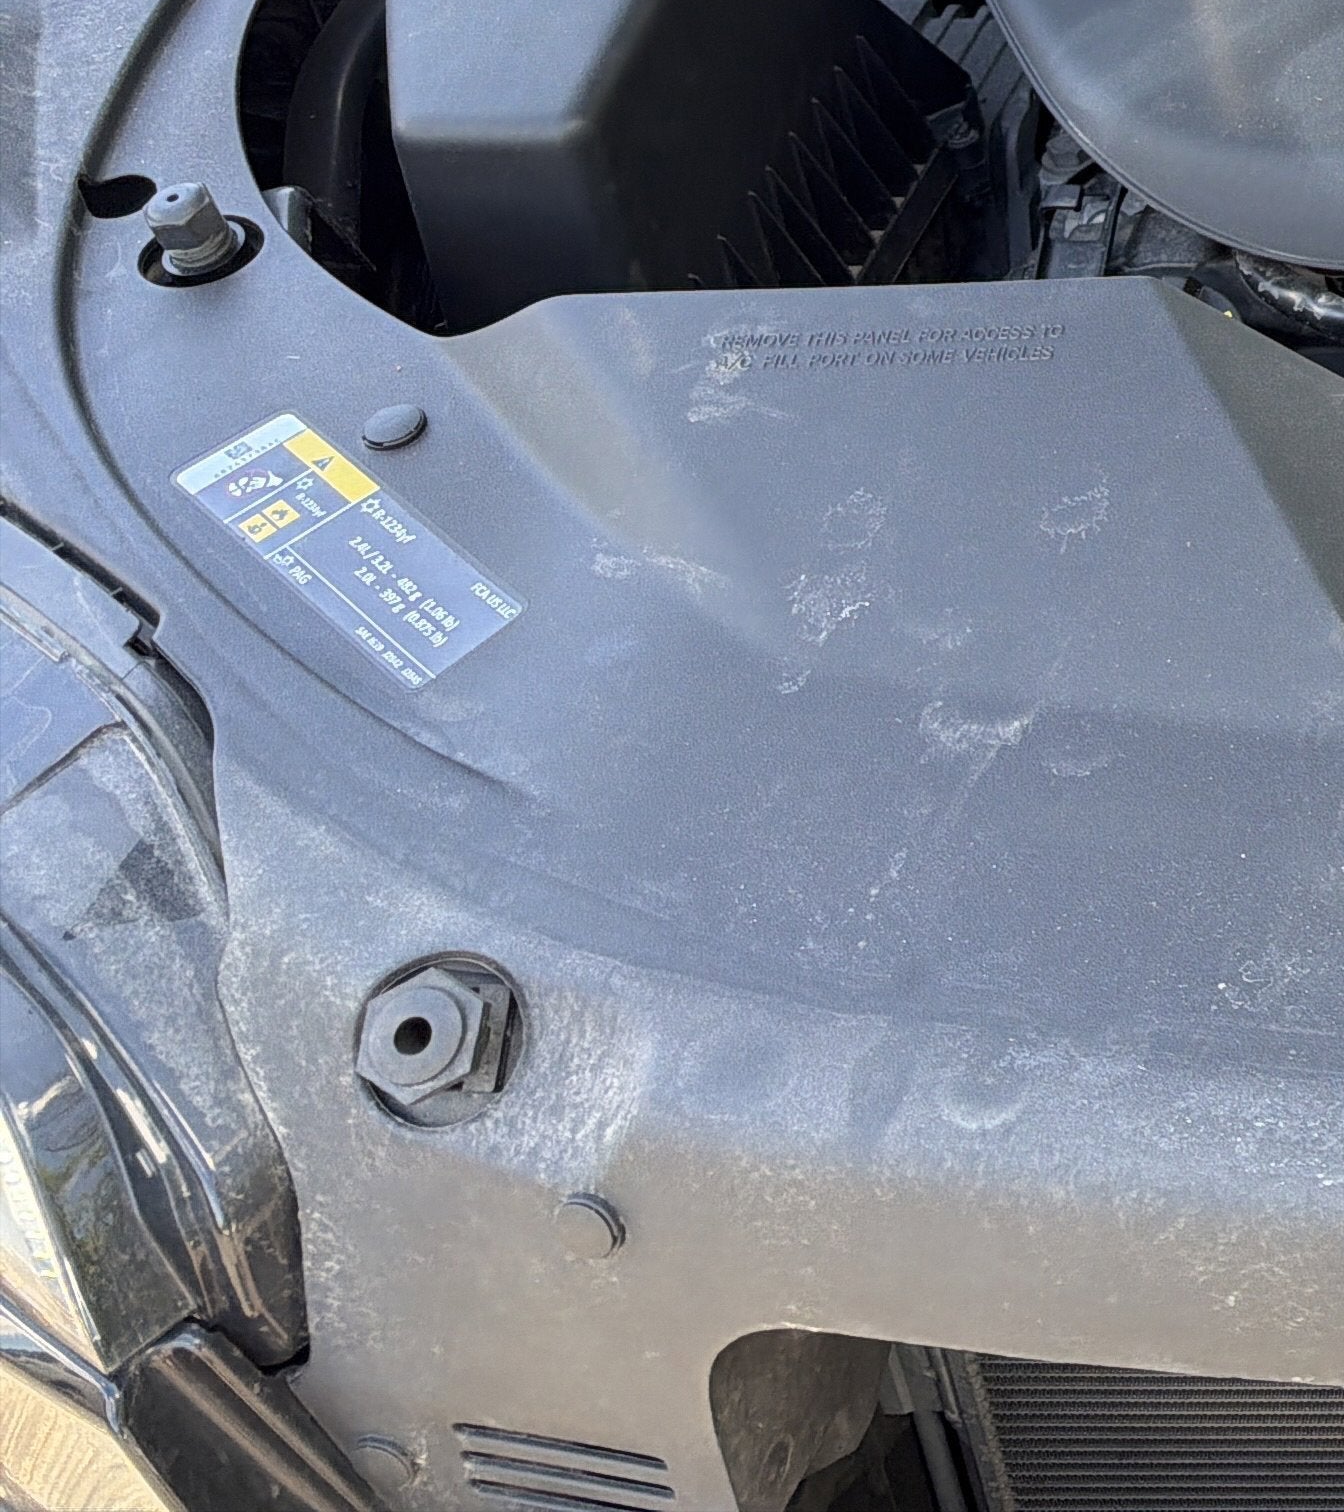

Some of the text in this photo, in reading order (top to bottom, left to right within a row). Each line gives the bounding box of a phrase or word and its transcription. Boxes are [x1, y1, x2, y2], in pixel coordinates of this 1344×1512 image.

[720, 323, 1065, 350] REMOVE THIS PANEL FOR ACCESS TO
[762, 353, 800, 370] FILL
[808, 351, 861, 368] PORT
[865, 350, 896, 367] ON
[900, 348, 957, 365] SOME
[962, 344, 1055, 363] VEHICLES
[289, 566, 312, 584] PAG
[470, 582, 490, 599] FCA
